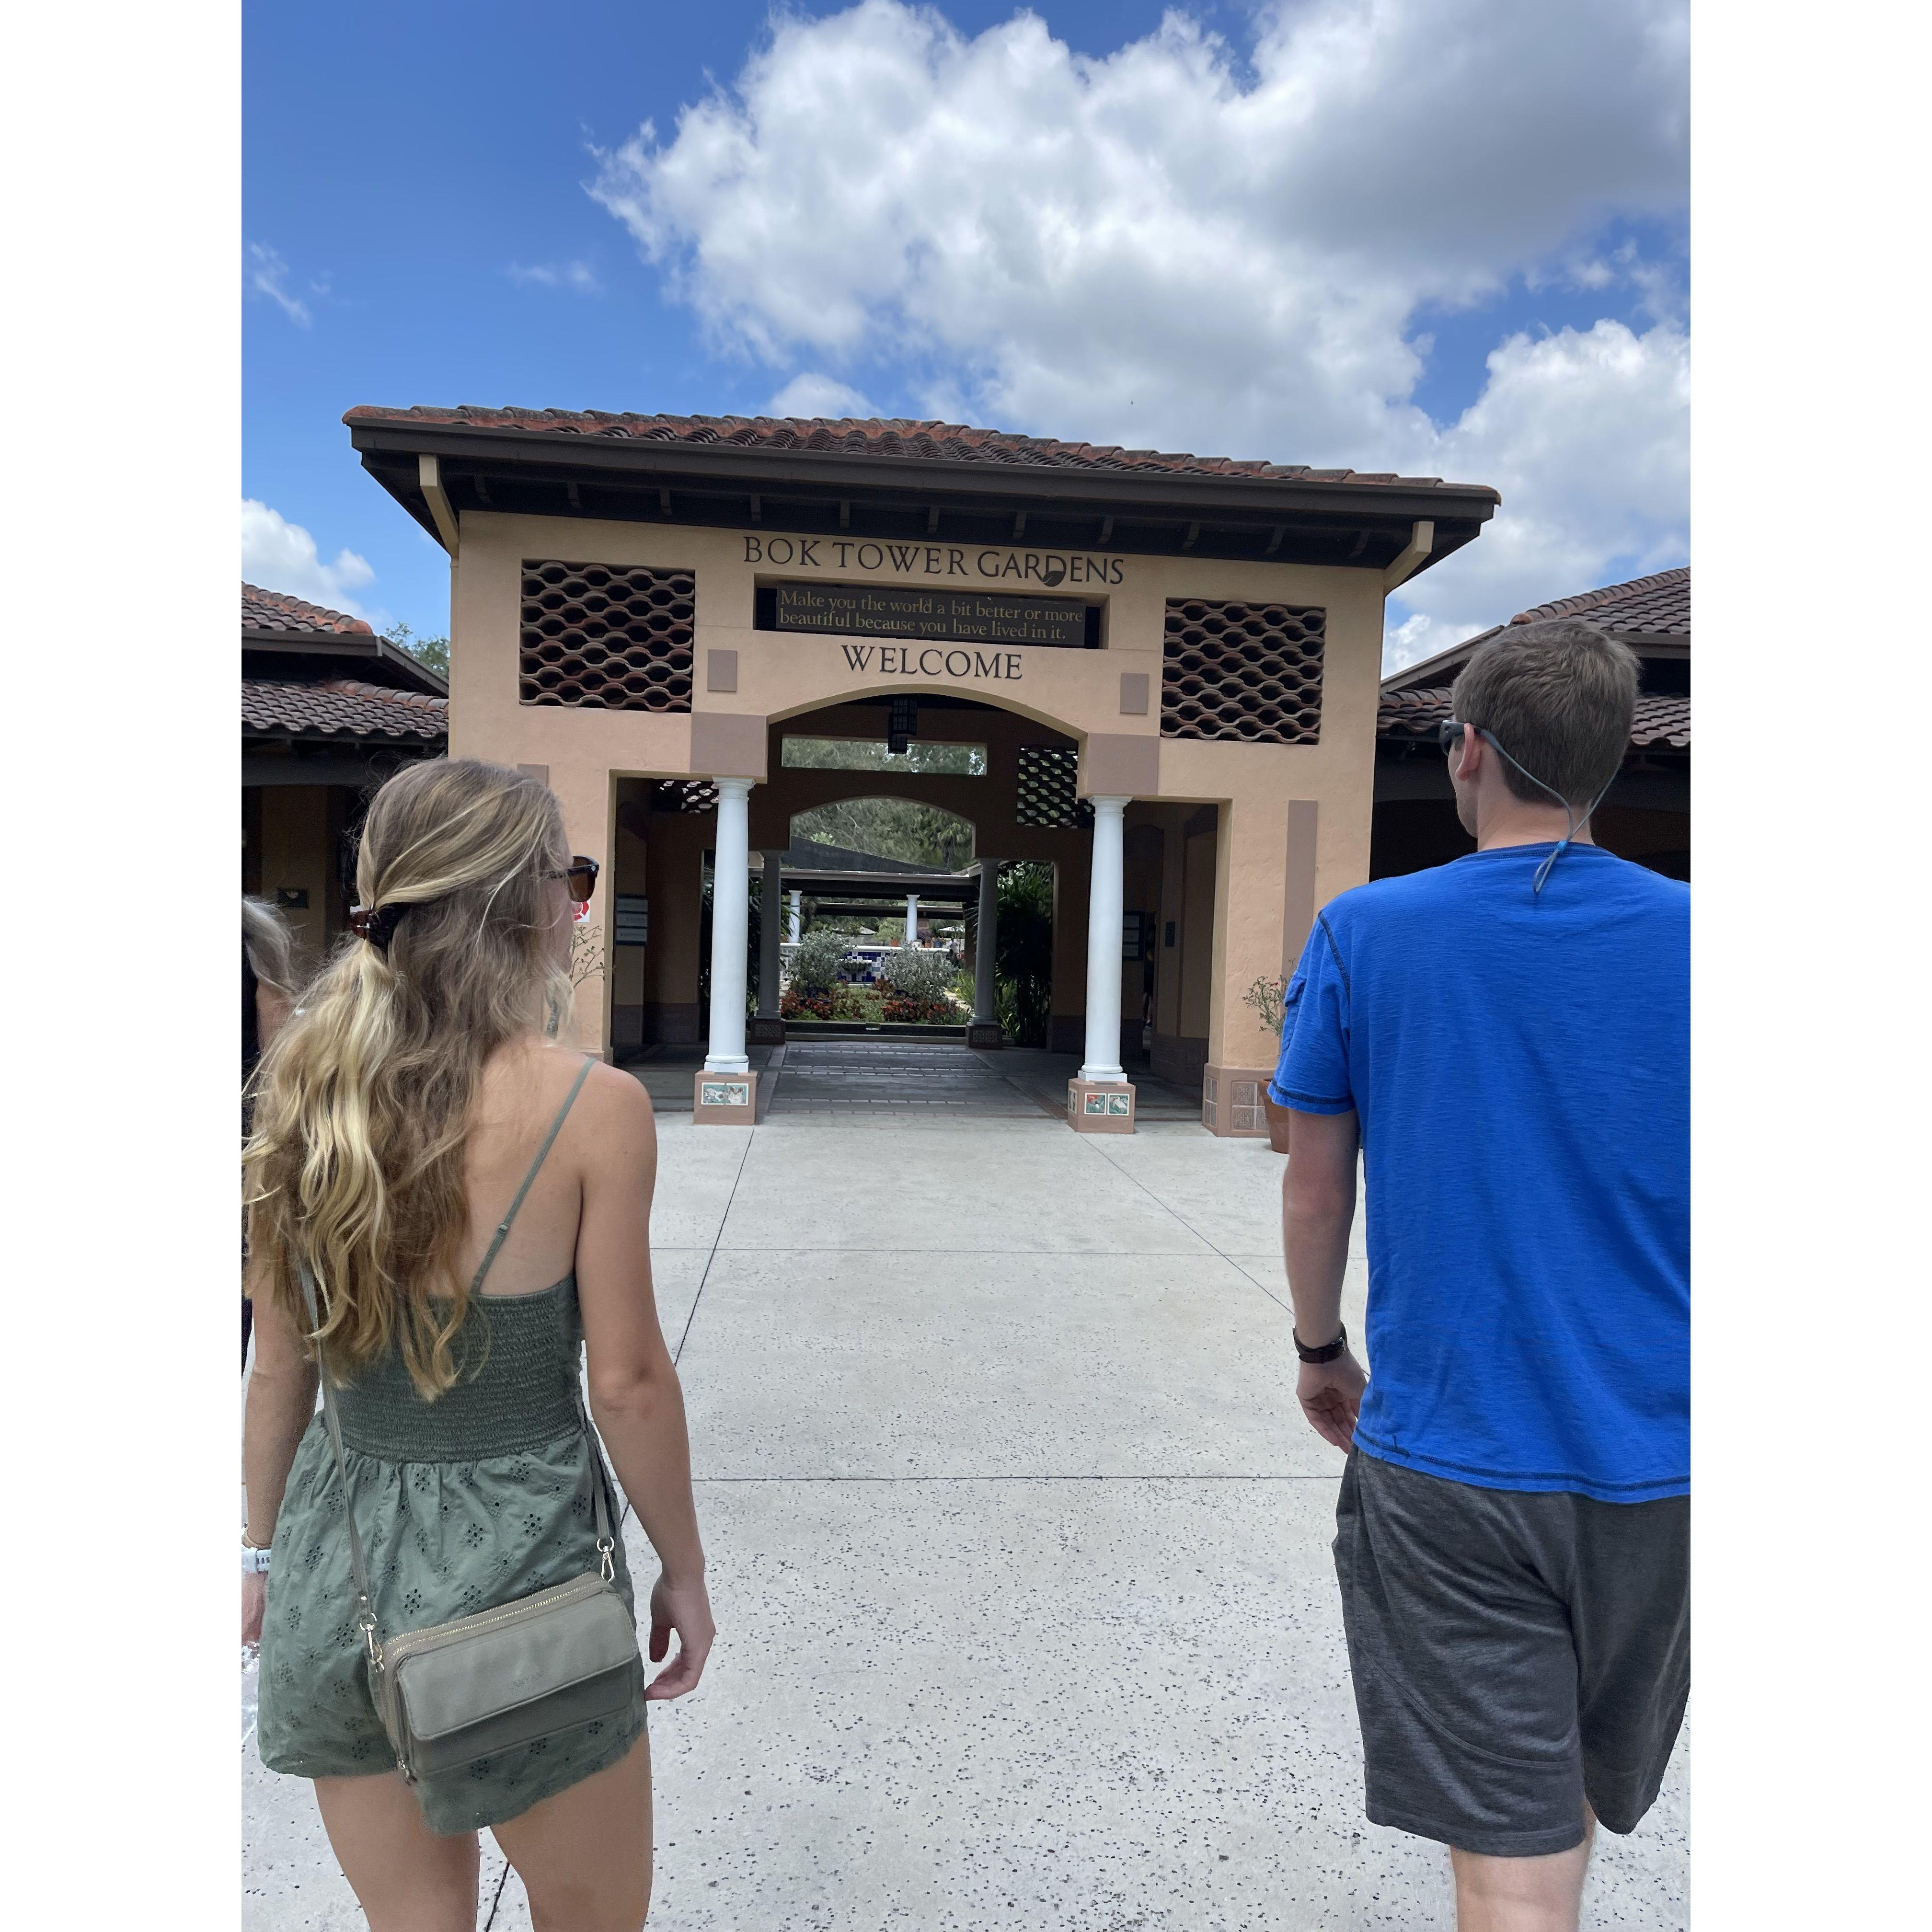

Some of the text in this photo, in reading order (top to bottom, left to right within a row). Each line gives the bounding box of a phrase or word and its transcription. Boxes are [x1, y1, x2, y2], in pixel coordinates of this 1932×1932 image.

[743, 536, 1124, 587] BOK TOWER GARDENS
[781, 589, 1083, 622] Make you the world a bit better or more
[780, 608, 1066, 639] beautiful because you have lived in it.
[840, 644, 1023, 680] WELCOME
